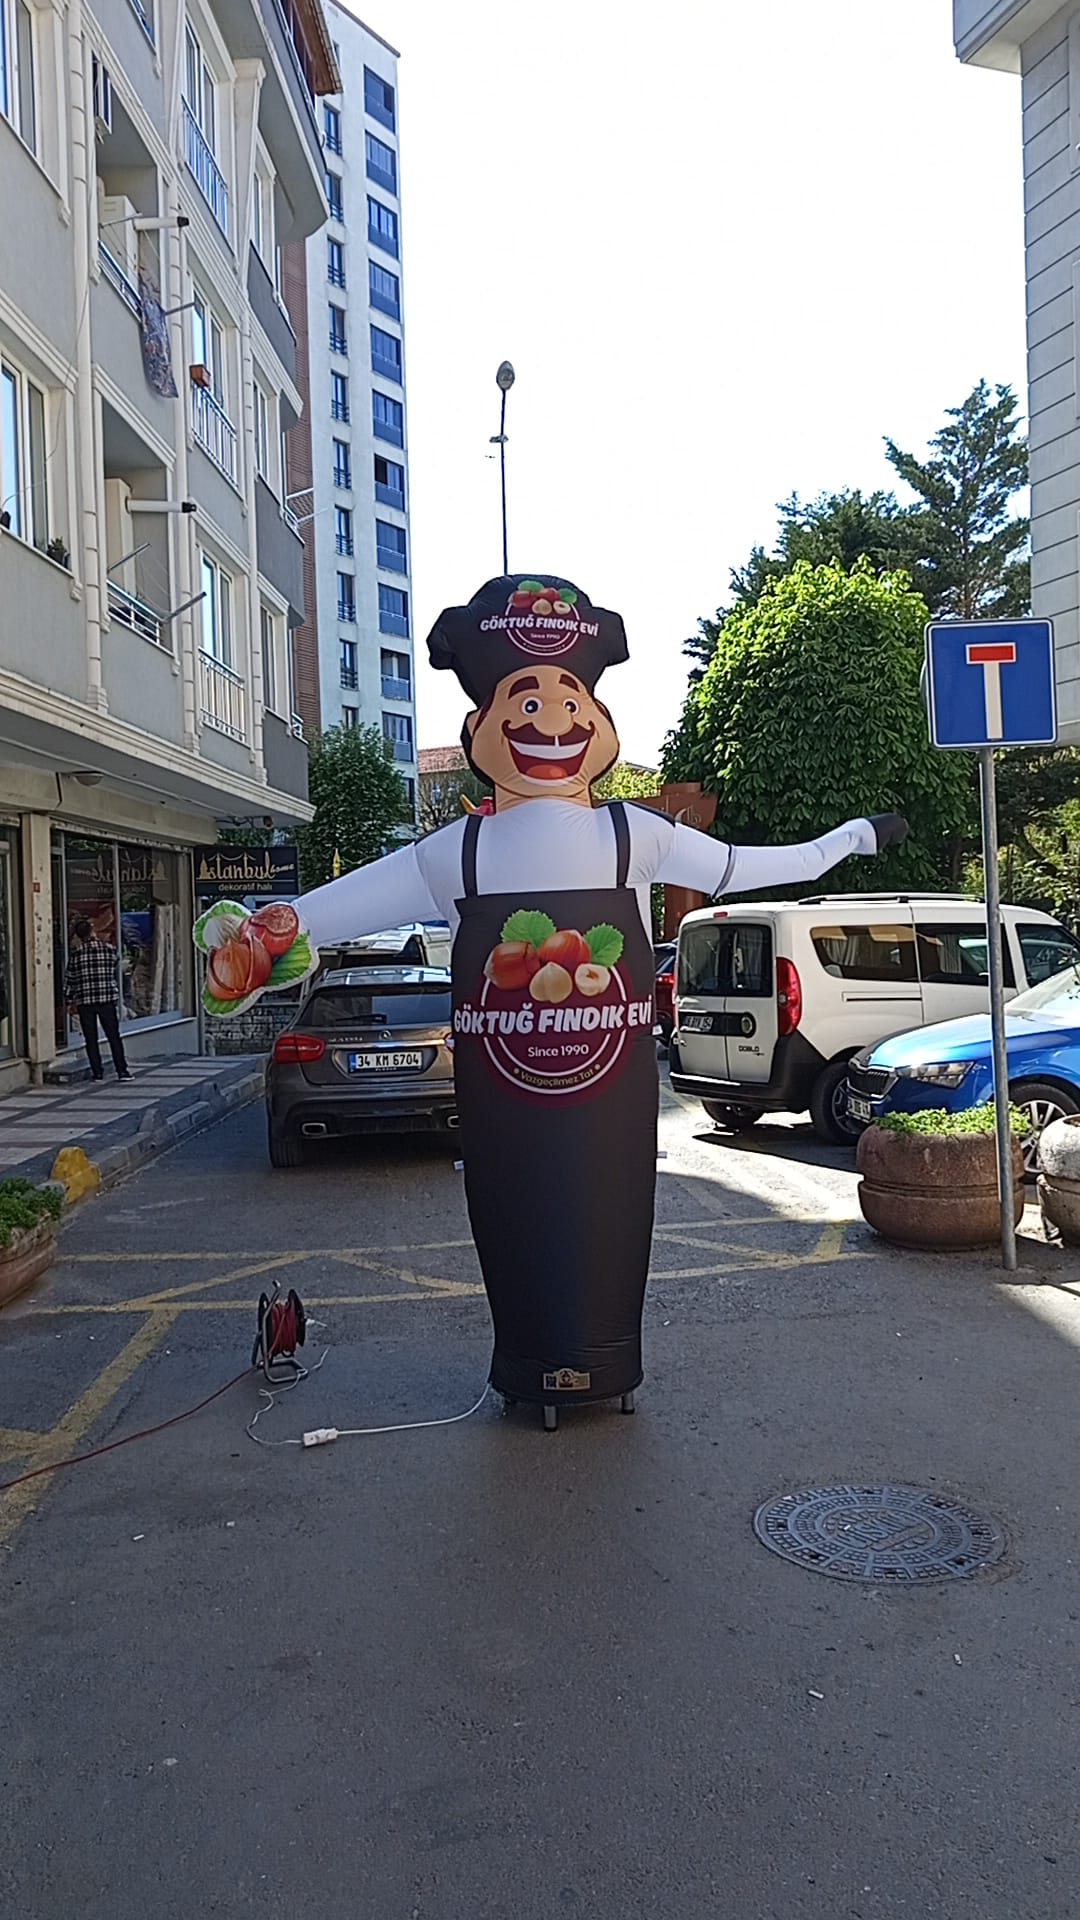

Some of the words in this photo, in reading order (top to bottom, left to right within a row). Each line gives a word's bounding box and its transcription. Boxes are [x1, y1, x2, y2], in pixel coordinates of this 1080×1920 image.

[480, 613, 534, 631] GÖKTUĞ
[535, 617, 579, 632] FINDIK
[579, 622, 600, 637] EVİ
[218, 882, 255, 892] dekoratif
[454, 1002, 534, 1034] GÖKTUĞ
[537, 1004, 625, 1033] FINDIK
[627, 994, 652, 1026] EVİ
[527, 1045, 559, 1057] Since
[560, 1043, 589, 1056] 1990
[358, 1055, 371, 1067] 34
[393, 1054, 419, 1066] 6704
[520, 1070, 579, 1087] Vazgeçilmez
[579, 1069, 595, 1081] Tat
